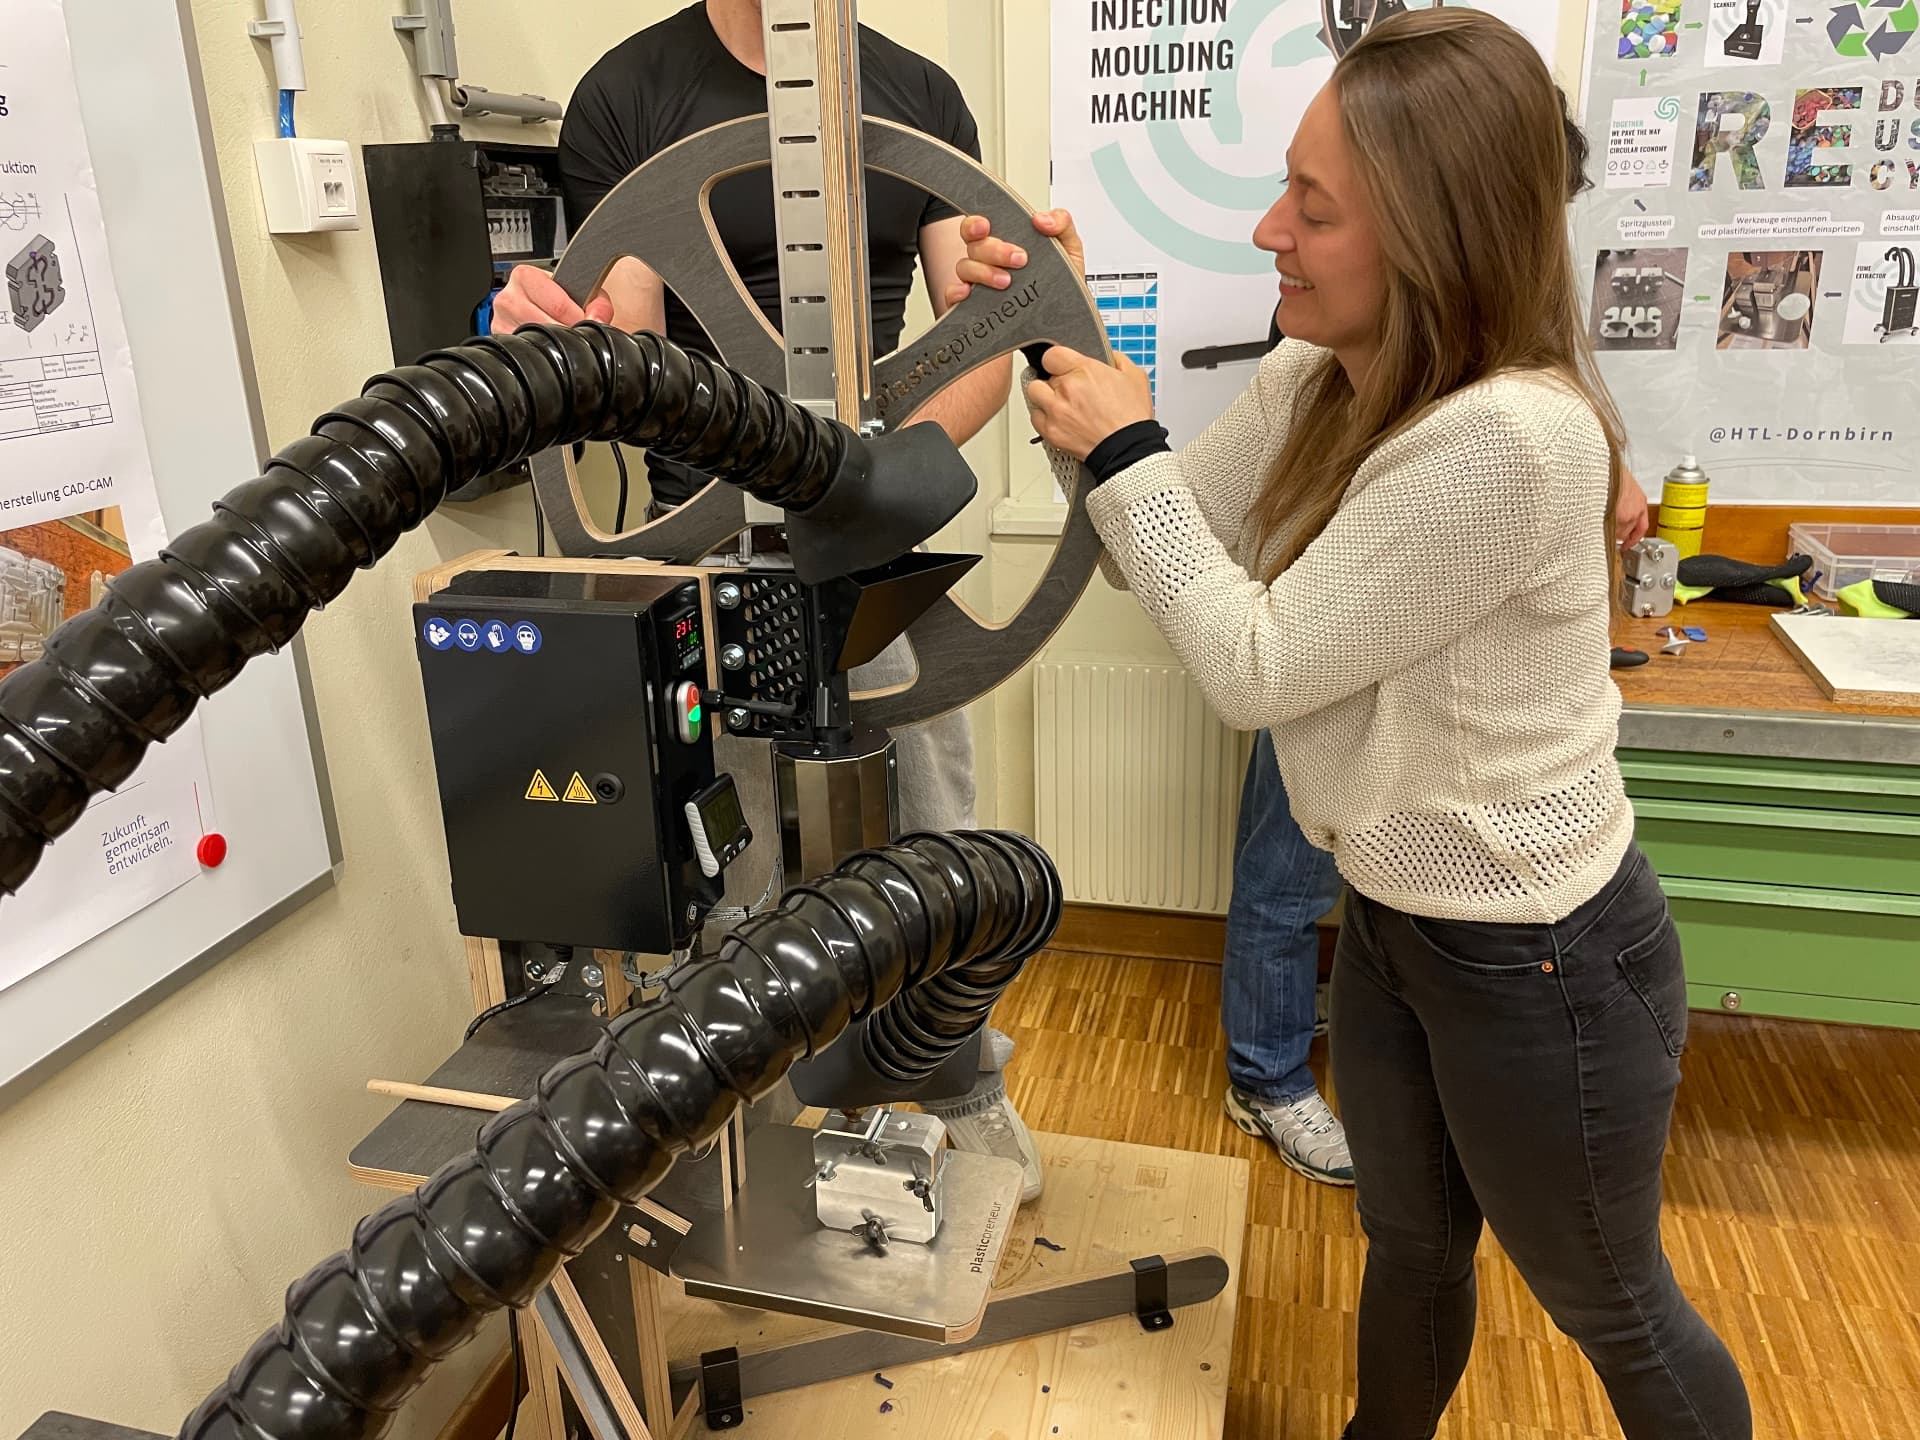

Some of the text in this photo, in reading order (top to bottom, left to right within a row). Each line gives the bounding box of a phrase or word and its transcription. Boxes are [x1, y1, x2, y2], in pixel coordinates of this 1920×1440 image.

[1091, 0, 1227, 31] INJECTION
[1091, 40, 1234, 78] MOULDING
[1091, 88, 1212, 124] MACHINE
[1613, 120, 1644, 129] TOGETHER
[1649, 128, 1661, 136] WAY
[1609, 145, 1668, 154] CIRCULAR ECONOMY
[1620, 218, 1672, 229] Spritzgussteil
[1701, 224, 1861, 236] und plastifizierter Kunststoff einspritzen
[1736, 215, 1827, 225] Werkzeuge einspannen
[1624, 229, 1665, 239] entformen
[875, 280, 1041, 417] plasticpreneur
[1709, 427, 1894, 443] @HTL-Dornbirn
[62, 476, 113, 497] CAD-CAM
[101, 814, 147, 847] Zukunft
[105, 820, 170, 864] gemeinsam
[109, 836, 173, 875] entwickeln.
[969, 1201, 1002, 1274] plasticpreneur
